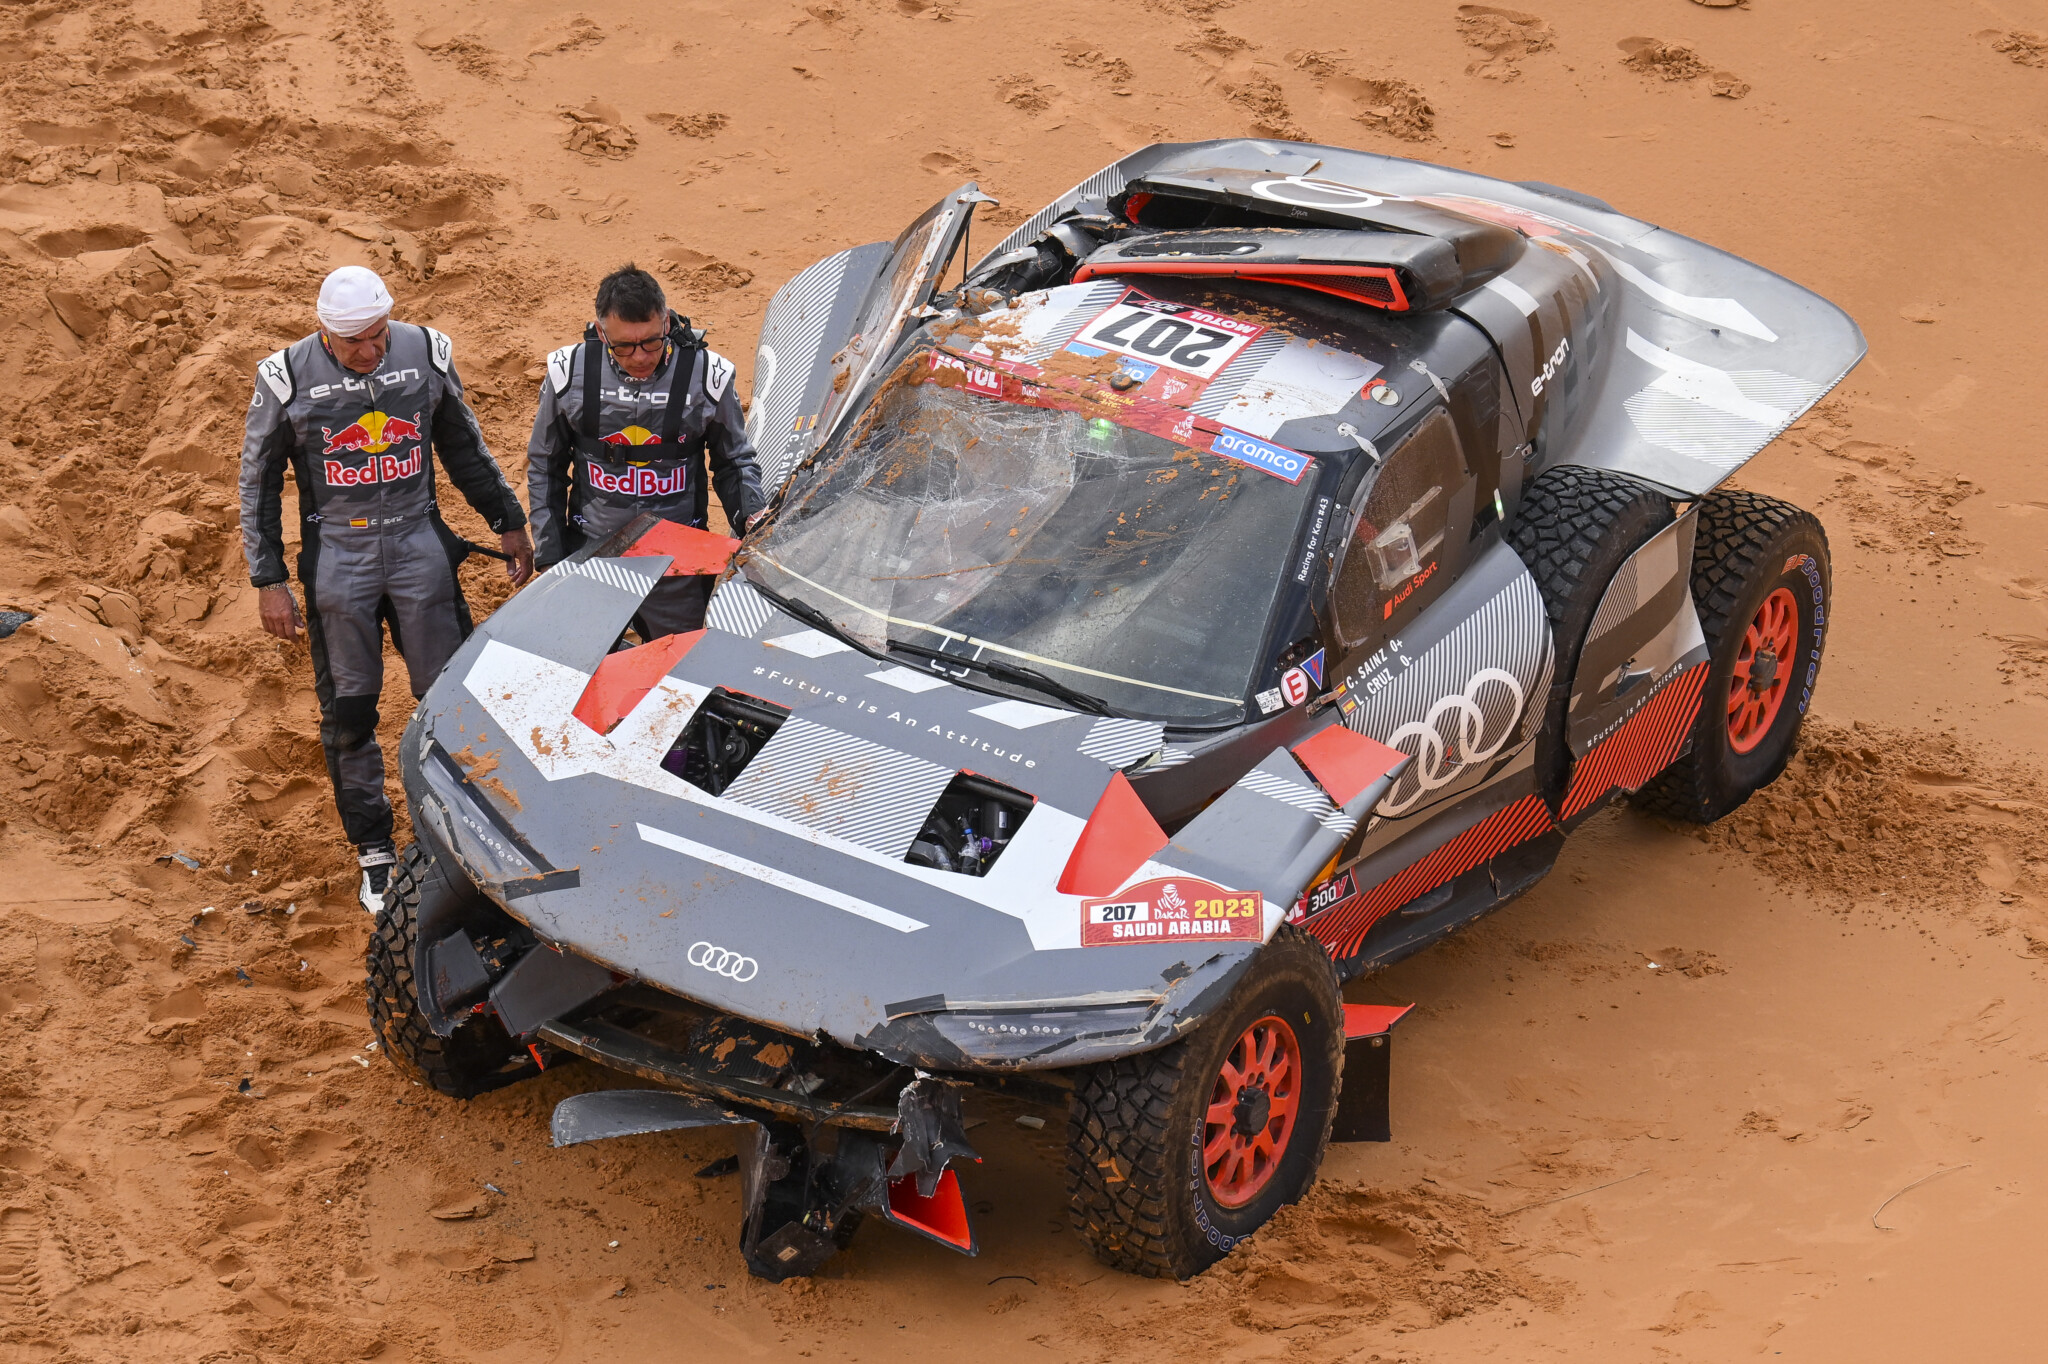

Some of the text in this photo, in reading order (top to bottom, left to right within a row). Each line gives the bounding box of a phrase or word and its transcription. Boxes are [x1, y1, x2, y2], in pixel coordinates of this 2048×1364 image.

[1092, 311, 1234, 368] 207
[1189, 311, 1257, 334] MOTUL
[310, 368, 419, 399] e-tron
[1531, 337, 1569, 397] e-tron
[787, 434, 800, 447] C.
[1220, 435, 1298, 471] aramco
[324, 446, 421, 486] Red Bull
[587, 461, 686, 496] Red Bull
[1298, 498, 1328, 581] Racing for Ken #43
[1394, 561, 1437, 608] Audi Sport
[1286, 672, 1304, 701] E
[1346, 676, 1358, 689] C.
[1358, 648, 1388, 679] SAINZ
[1354, 694, 1368, 706] L.
[1367, 668, 1394, 694] CRUZ
[753, 666, 1037, 769] #Future Is An Attitude
[1587, 663, 1683, 748] #Future Is An Attitude
[1102, 898, 1254, 921] 207 DAKAR 2023
[1312, 875, 1349, 911] 300V
[1112, 919, 1231, 938] SAUDI ARABIA
